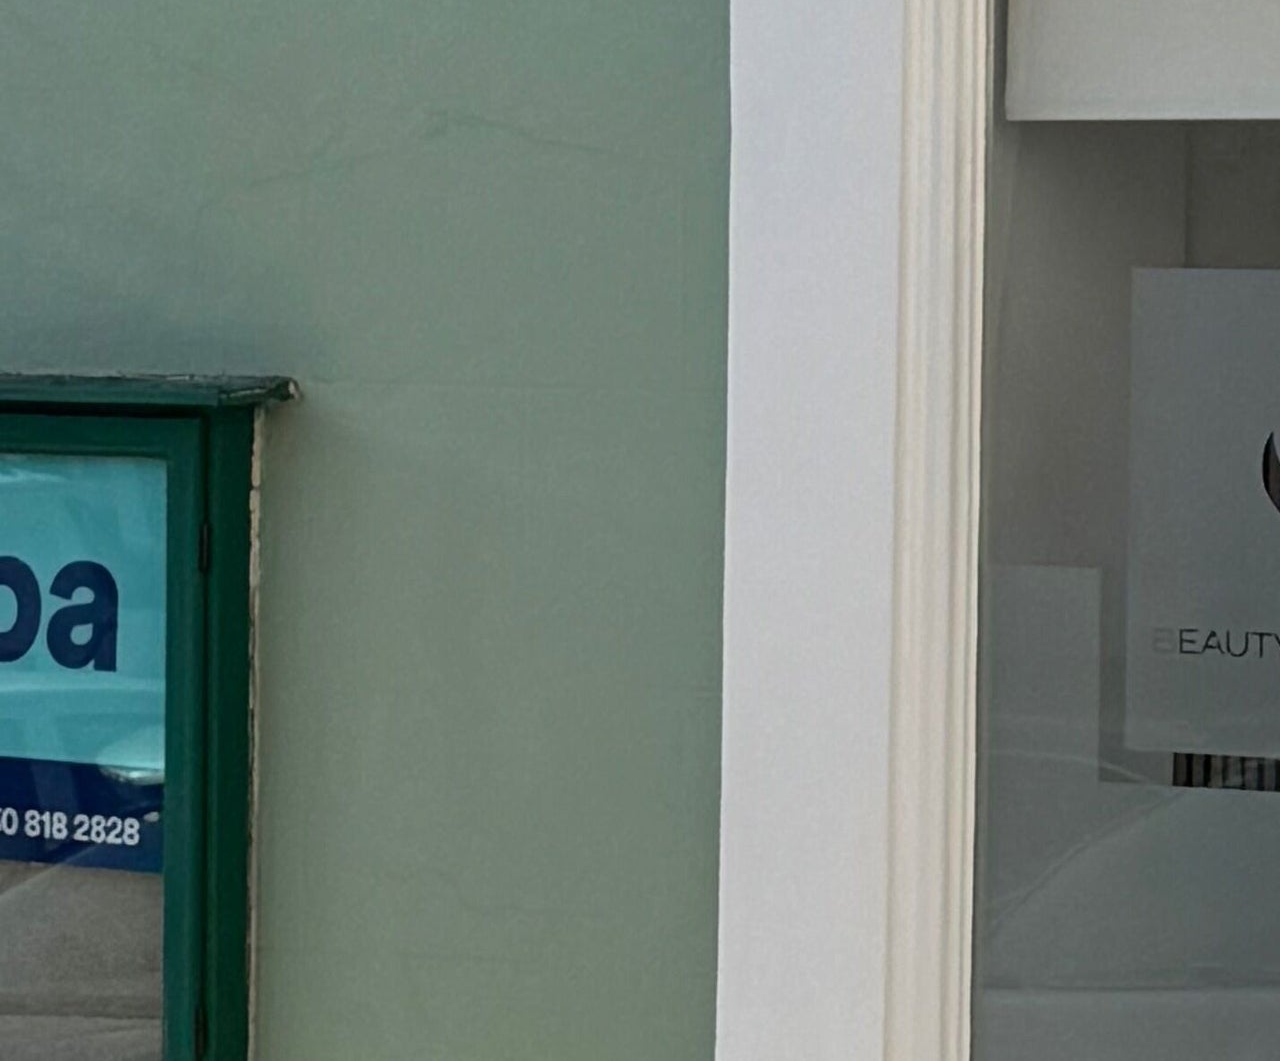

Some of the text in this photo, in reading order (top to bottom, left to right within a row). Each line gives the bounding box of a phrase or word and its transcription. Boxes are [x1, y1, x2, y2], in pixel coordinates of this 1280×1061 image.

[0, 806, 140, 846] 0 818 2828
